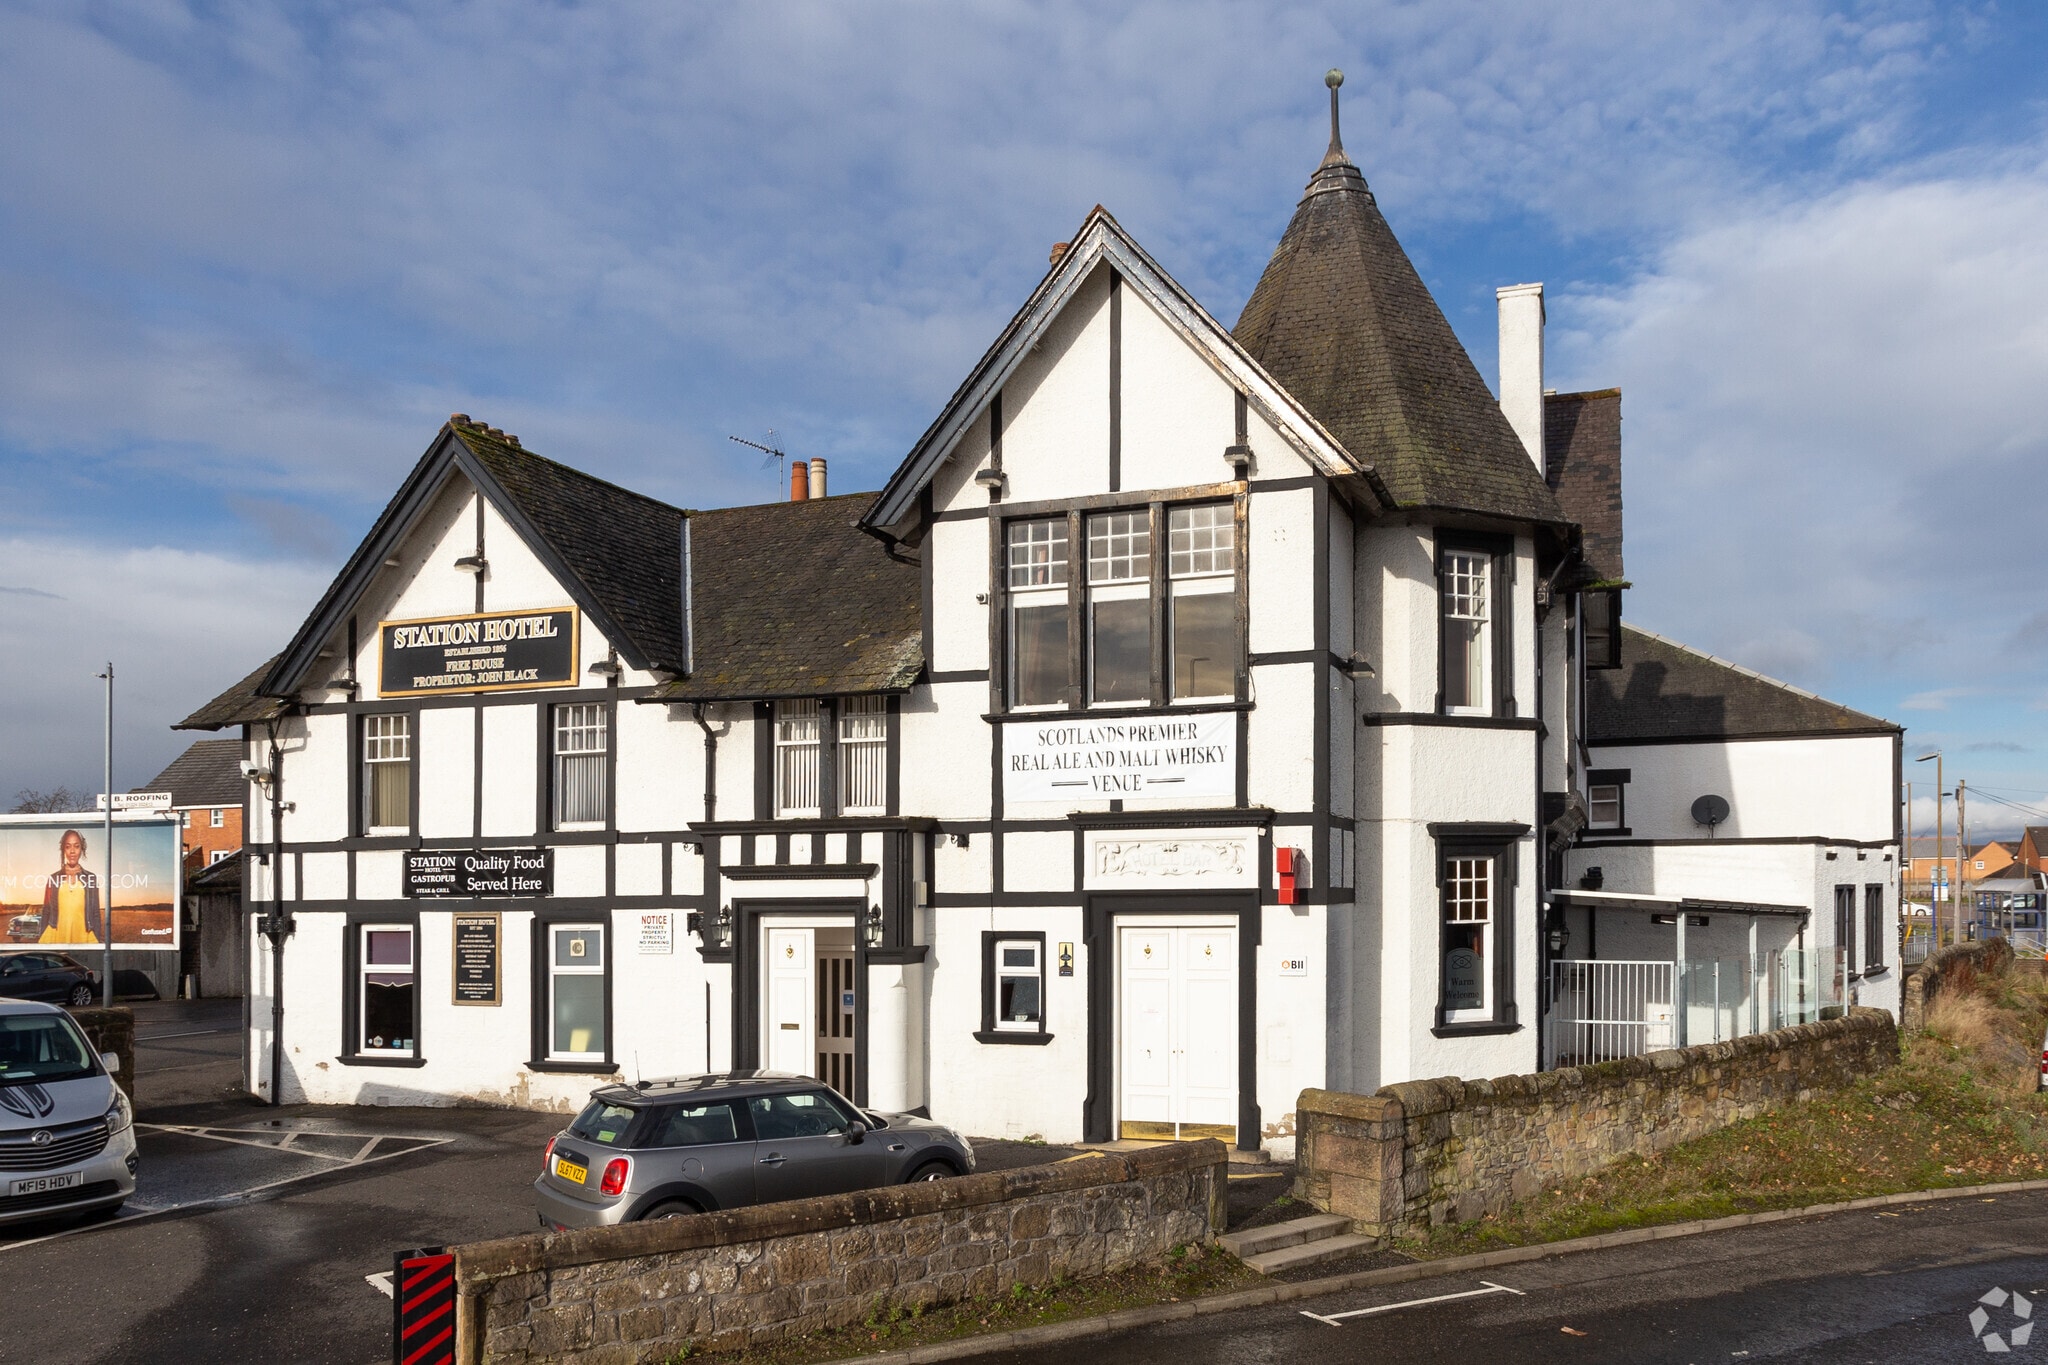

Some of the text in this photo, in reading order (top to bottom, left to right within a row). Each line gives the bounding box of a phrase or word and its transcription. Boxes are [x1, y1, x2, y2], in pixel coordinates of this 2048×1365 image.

[393, 615, 558, 649] STATION HOTEL
[444, 646, 491, 657] ESTABLISHED
[445, 657, 504, 672] FREE HOUSE
[413, 669, 538, 688] PROPRIETOR: JOHN BLACK
[1038, 722, 1198, 746] SCOTLANDS PREMIER
[1011, 745, 1228, 771] REAL ALE AND MALT WHISKY
[1092, 774, 1142, 792] VENUE
[410, 856, 456, 868] STATION
[464, 855, 545, 873] Quality Food
[1131, 852, 1212, 867] HOTEL BAR
[22, 874, 148, 889] CONFUSEDCOM
[411, 875, 455, 883] GASTROPUB
[467, 877, 542, 890] Served Here
[641, 915, 667, 924] NOTICE
[1451, 977, 1475, 986] Warm
[1446, 990, 1480, 999] Welcome
[18, 1175, 73, 1193] MF19 HDV
